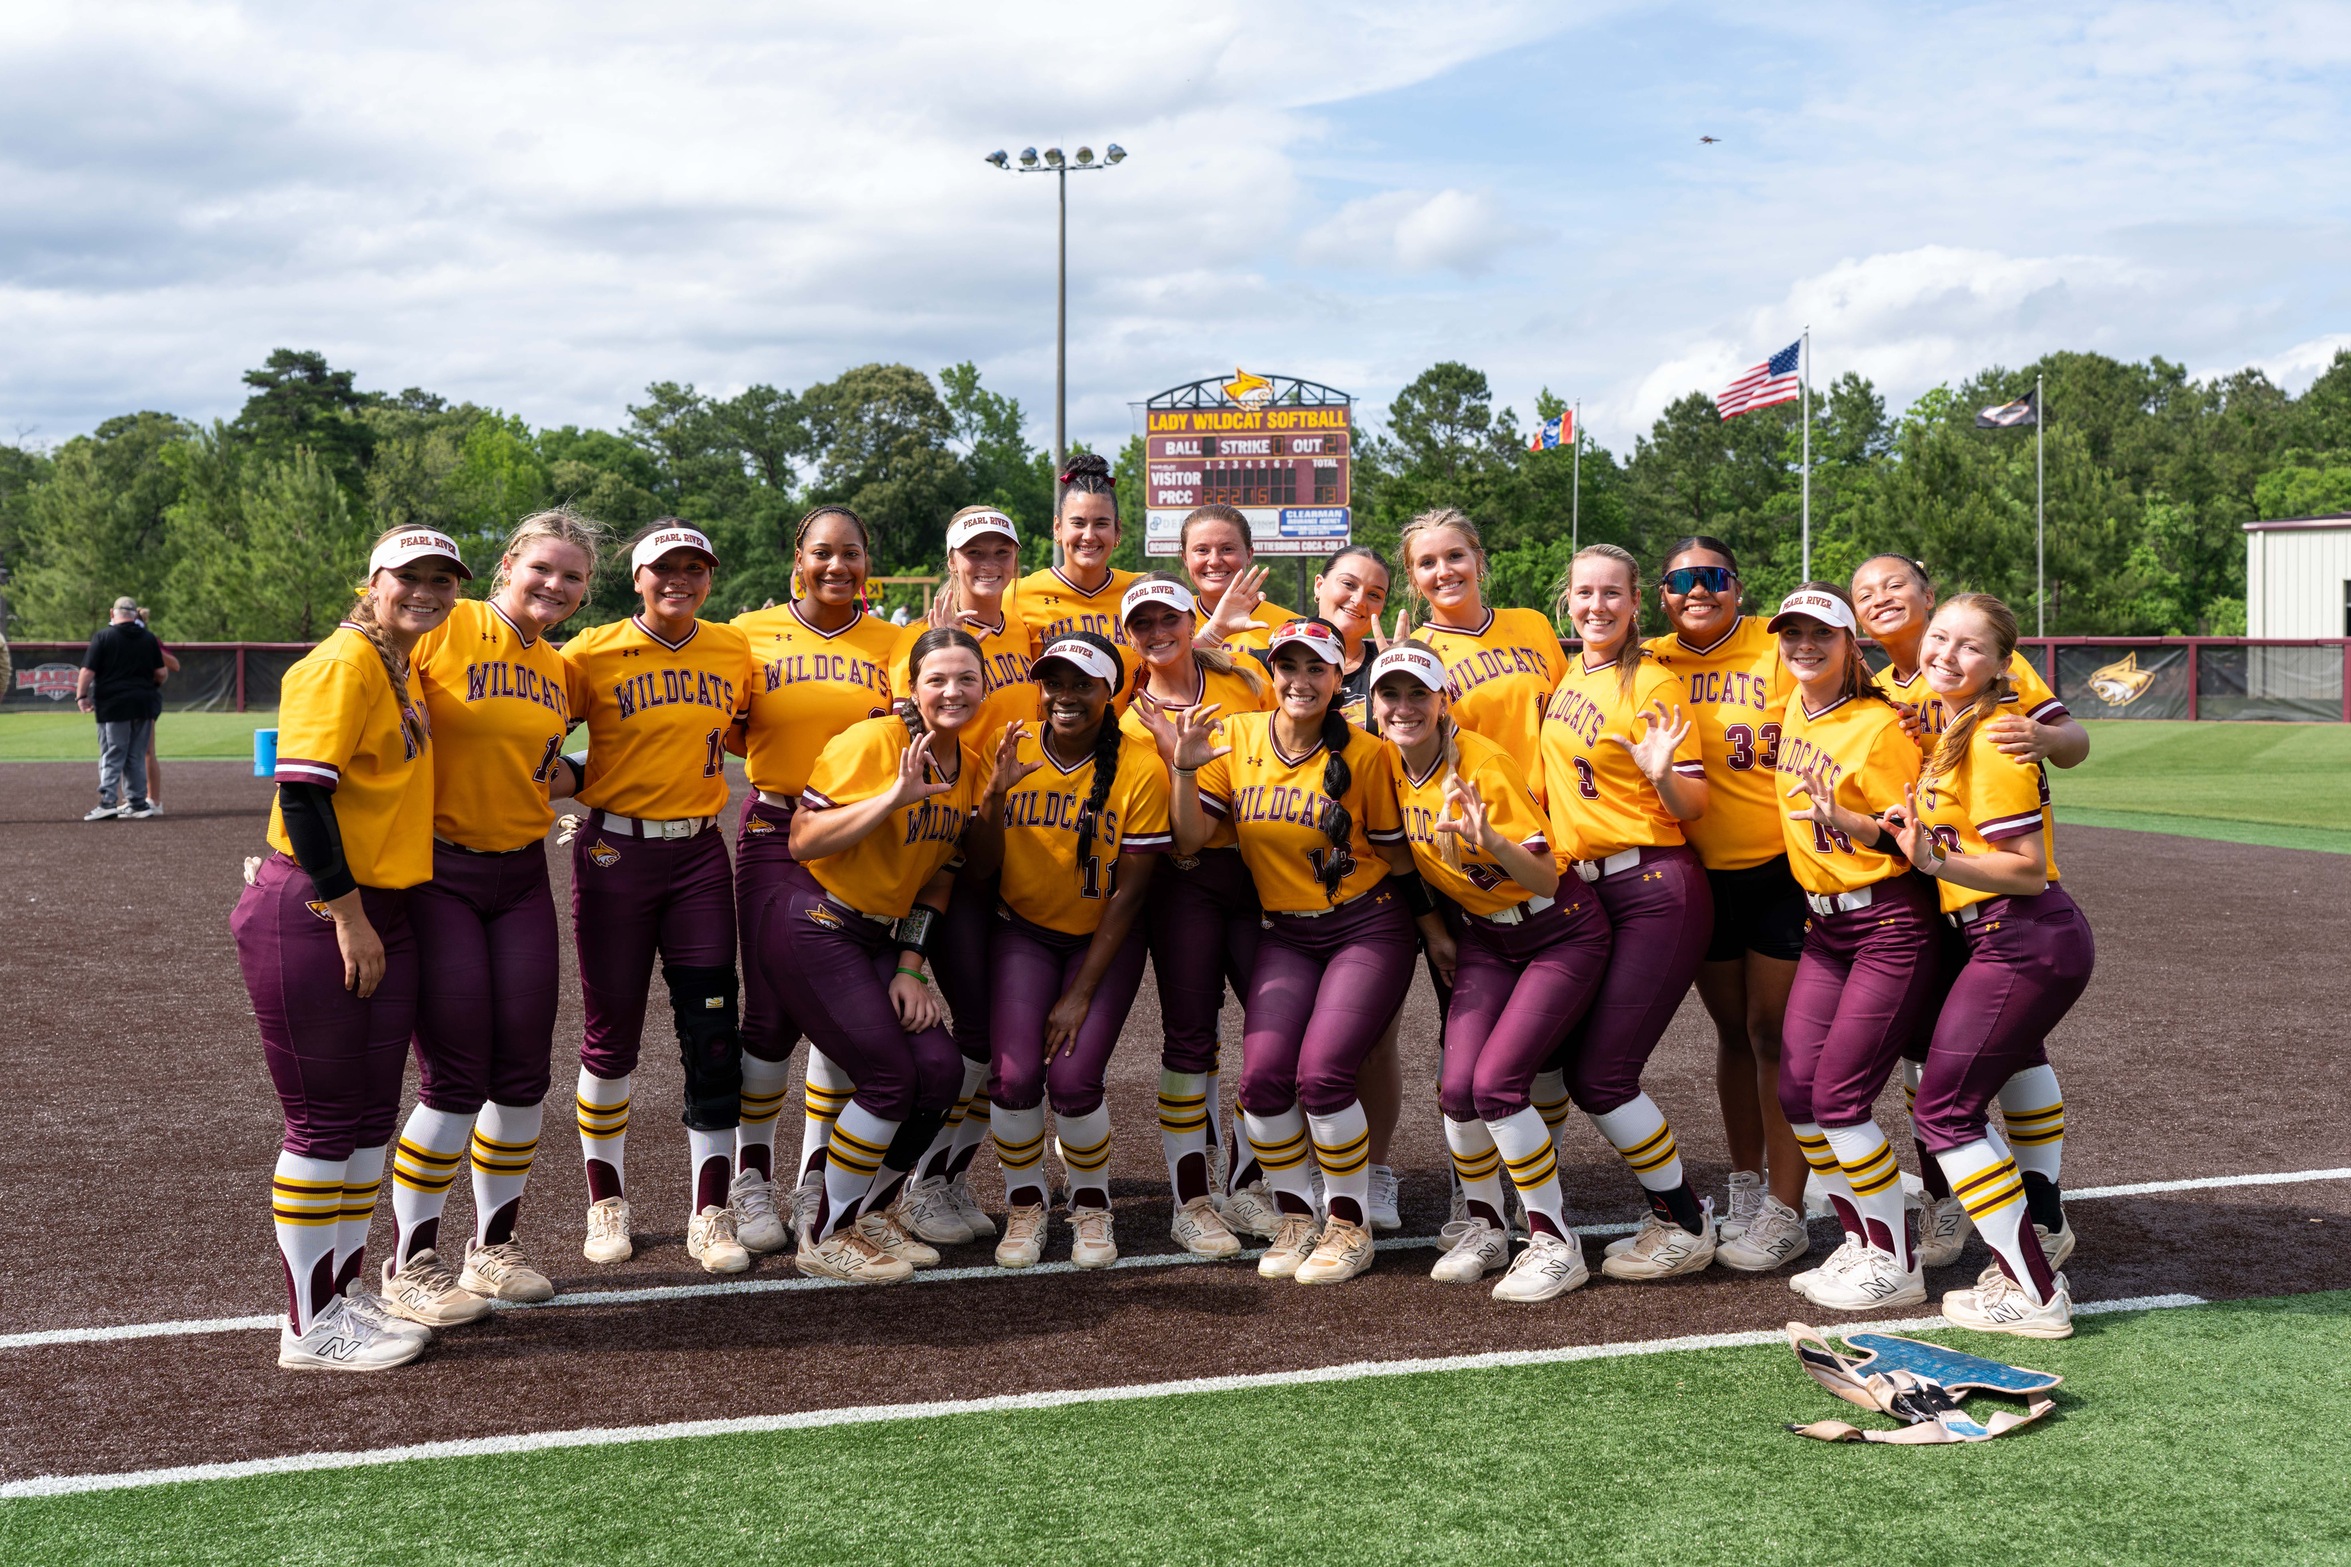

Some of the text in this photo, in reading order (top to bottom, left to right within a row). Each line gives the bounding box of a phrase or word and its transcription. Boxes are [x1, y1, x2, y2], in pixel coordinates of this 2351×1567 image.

[1149, 410, 1347, 431] LADY WILDCAT SOFTBALL
[1165, 441, 1201, 455] BALL
[1220, 440, 1270, 454] STRIKE
[1292, 439, 1322, 453] OUT
[1325, 435, 1336, 455] 2
[1232, 460, 1239, 468] 3
[1245, 460, 1252, 468] 4
[1260, 460, 1266, 468] 5
[1273, 459, 1280, 467] 6
[1287, 459, 1294, 467] 7
[1312, 458, 1338, 467] TOTAL
[1150, 472, 1201, 485] VISITOR
[1158, 490, 1193, 504] PRCC
[964, 516, 1010, 530] PEARL RIVER
[1286, 509, 1343, 518] CLEARMAN
[400, 536, 457, 556] PEARL RIVER
[654, 533, 704, 548] PEARL RIVER
[1127, 585, 1175, 604] PEARL RIVER
[1782, 595, 1832, 611] PEARL RIVER
[1046, 644, 1094, 660] PEARL RIVER
[1380, 653, 1432, 670] PEARL RIVER
[763, 653, 889, 699] WILDCATS
[1446, 645, 1551, 706] WILDCATS
[465, 660, 570, 725] WILDCATS
[613, 668, 734, 722] WILDCATS
[1724, 722, 1782, 771] 33
[532, 733, 560, 784] 1
[1572, 754, 1600, 800] 3
[1231, 785, 1332, 832] WILDCAT
[1234, 1200, 1263, 1222] N
[1179, 1220, 1202, 1241] N
[1339, 1244, 1367, 1266] N
[1477, 1242, 1500, 1264] N
[1652, 1244, 1691, 1269] N
[1766, 1238, 1795, 1260] N
[478, 1259, 504, 1282] N
[824, 1248, 866, 1273] N
[1540, 1259, 1570, 1280] N
[399, 1286, 432, 1311] N
[1859, 1276, 1898, 1300] N
[1987, 1302, 2024, 1324] N
[316, 1336, 362, 1361] N
